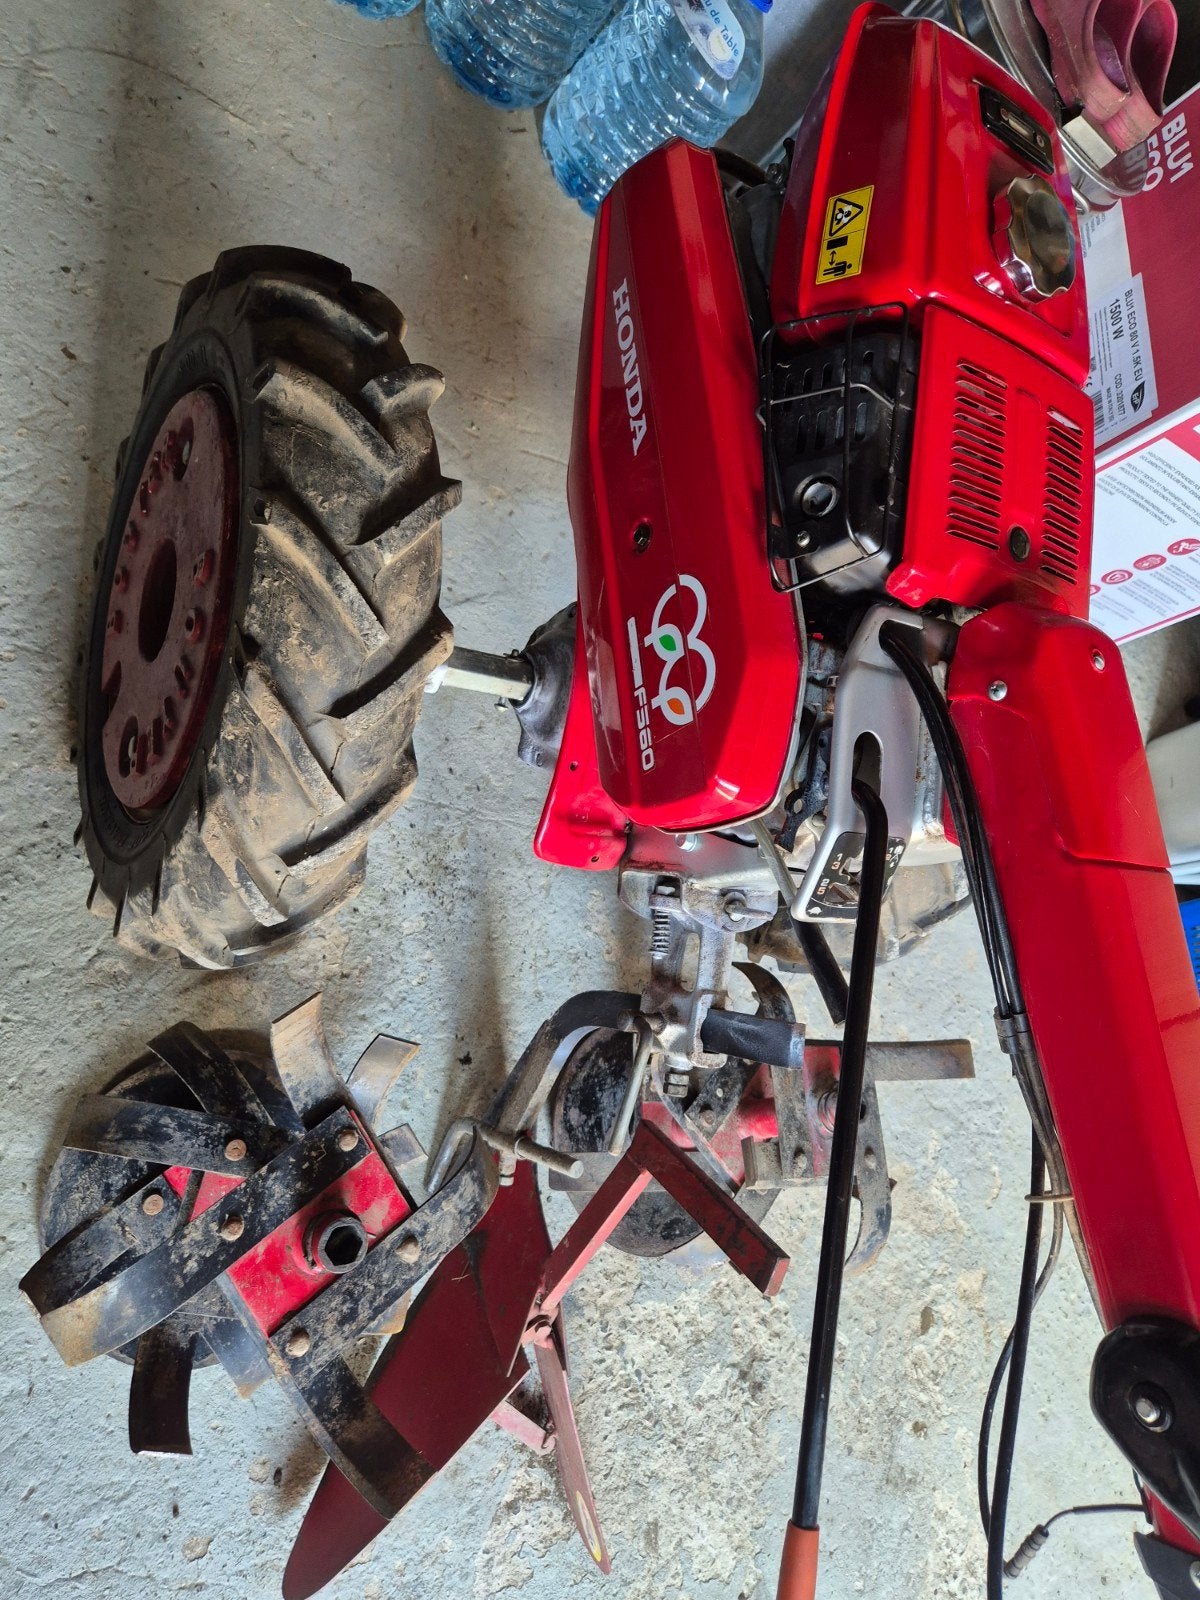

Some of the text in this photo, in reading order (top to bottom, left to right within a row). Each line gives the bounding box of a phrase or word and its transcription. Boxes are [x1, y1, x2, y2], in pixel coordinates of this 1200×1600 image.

[710, 9, 720, 24] de
[721, 25, 739, 56] Table
[1161, 113, 1194, 184] BLU1
[1124, 289, 1135, 311] BLU1
[1109, 298, 1124, 340] 1500 W
[1127, 310, 1137, 331] ECO
[1129, 330, 1139, 341] 80
[612, 278, 648, 457] HONDA
[1134, 368, 1143, 382] EU
[633, 686, 655, 771] F560
[831, 861, 840, 870] 3
[837, 853, 843, 861] 1
[817, 887, 826, 895] 5
[821, 879, 830, 887] 2
